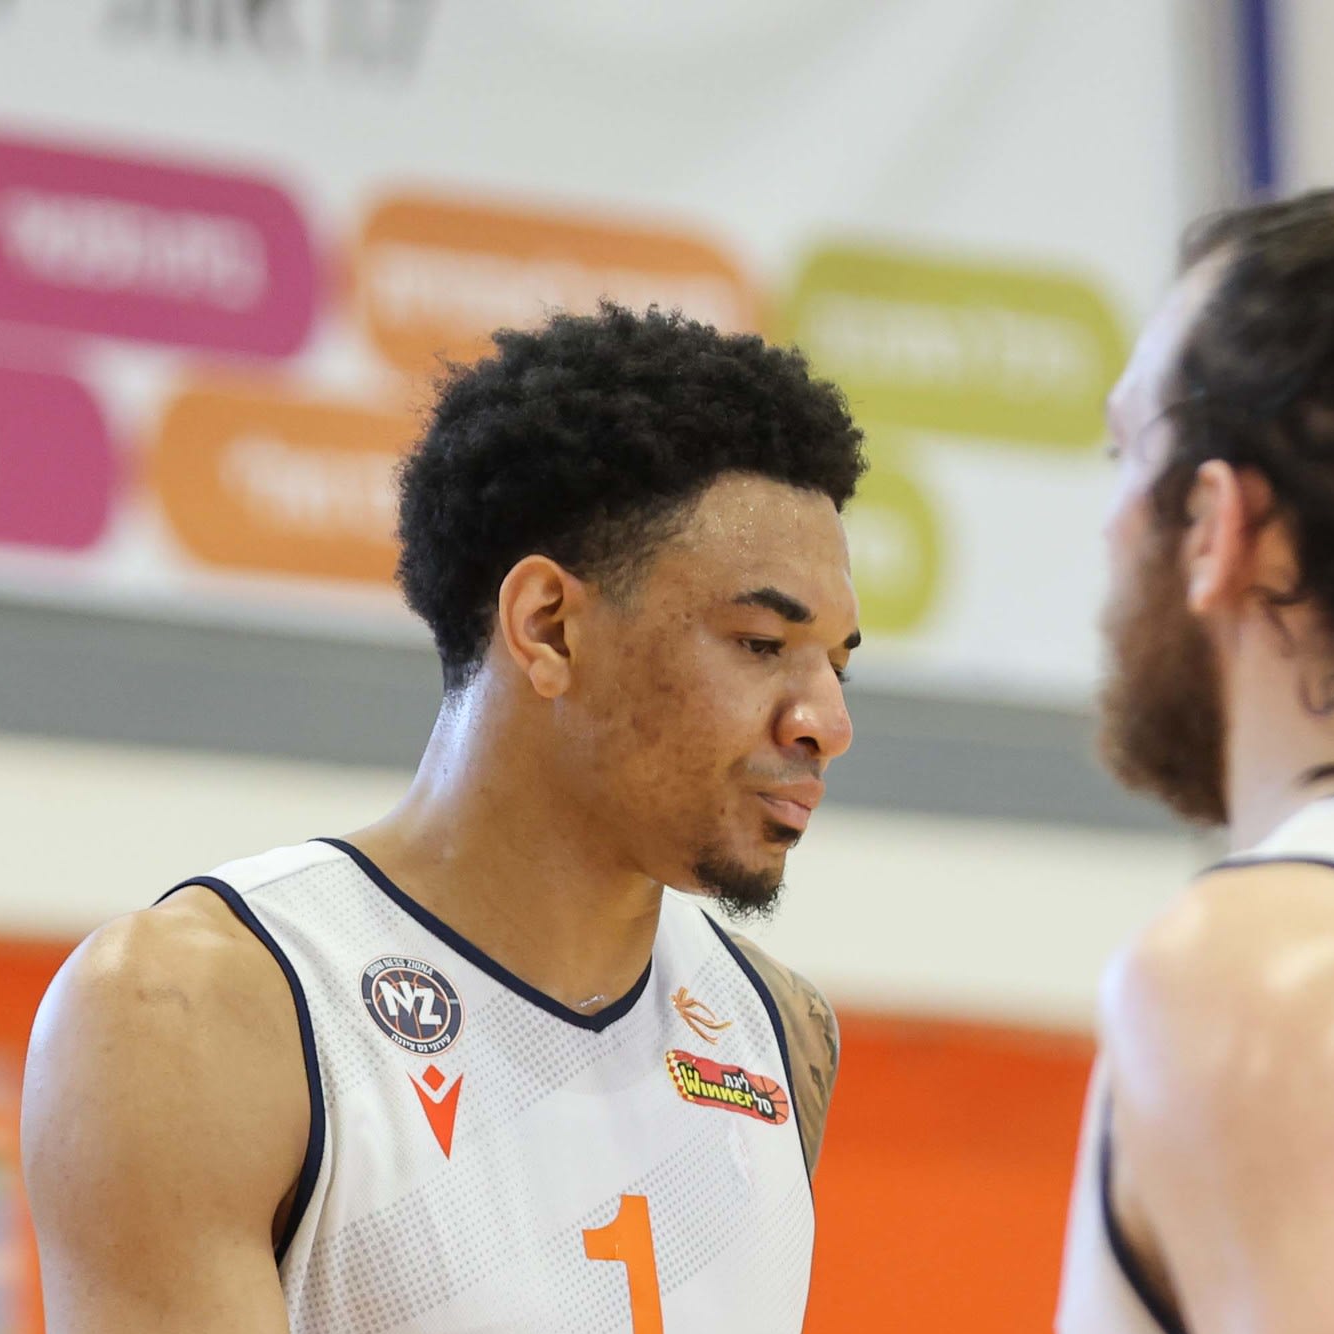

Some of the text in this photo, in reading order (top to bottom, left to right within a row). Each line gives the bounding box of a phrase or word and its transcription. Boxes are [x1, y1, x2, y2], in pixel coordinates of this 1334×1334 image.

[406, 960, 434, 977] ZIONA
[378, 980, 443, 1025] NZ
[679, 1063, 754, 1108] Winner
[723, 1071, 750, 1093] ליגת
[752, 1089, 773, 1115] סל
